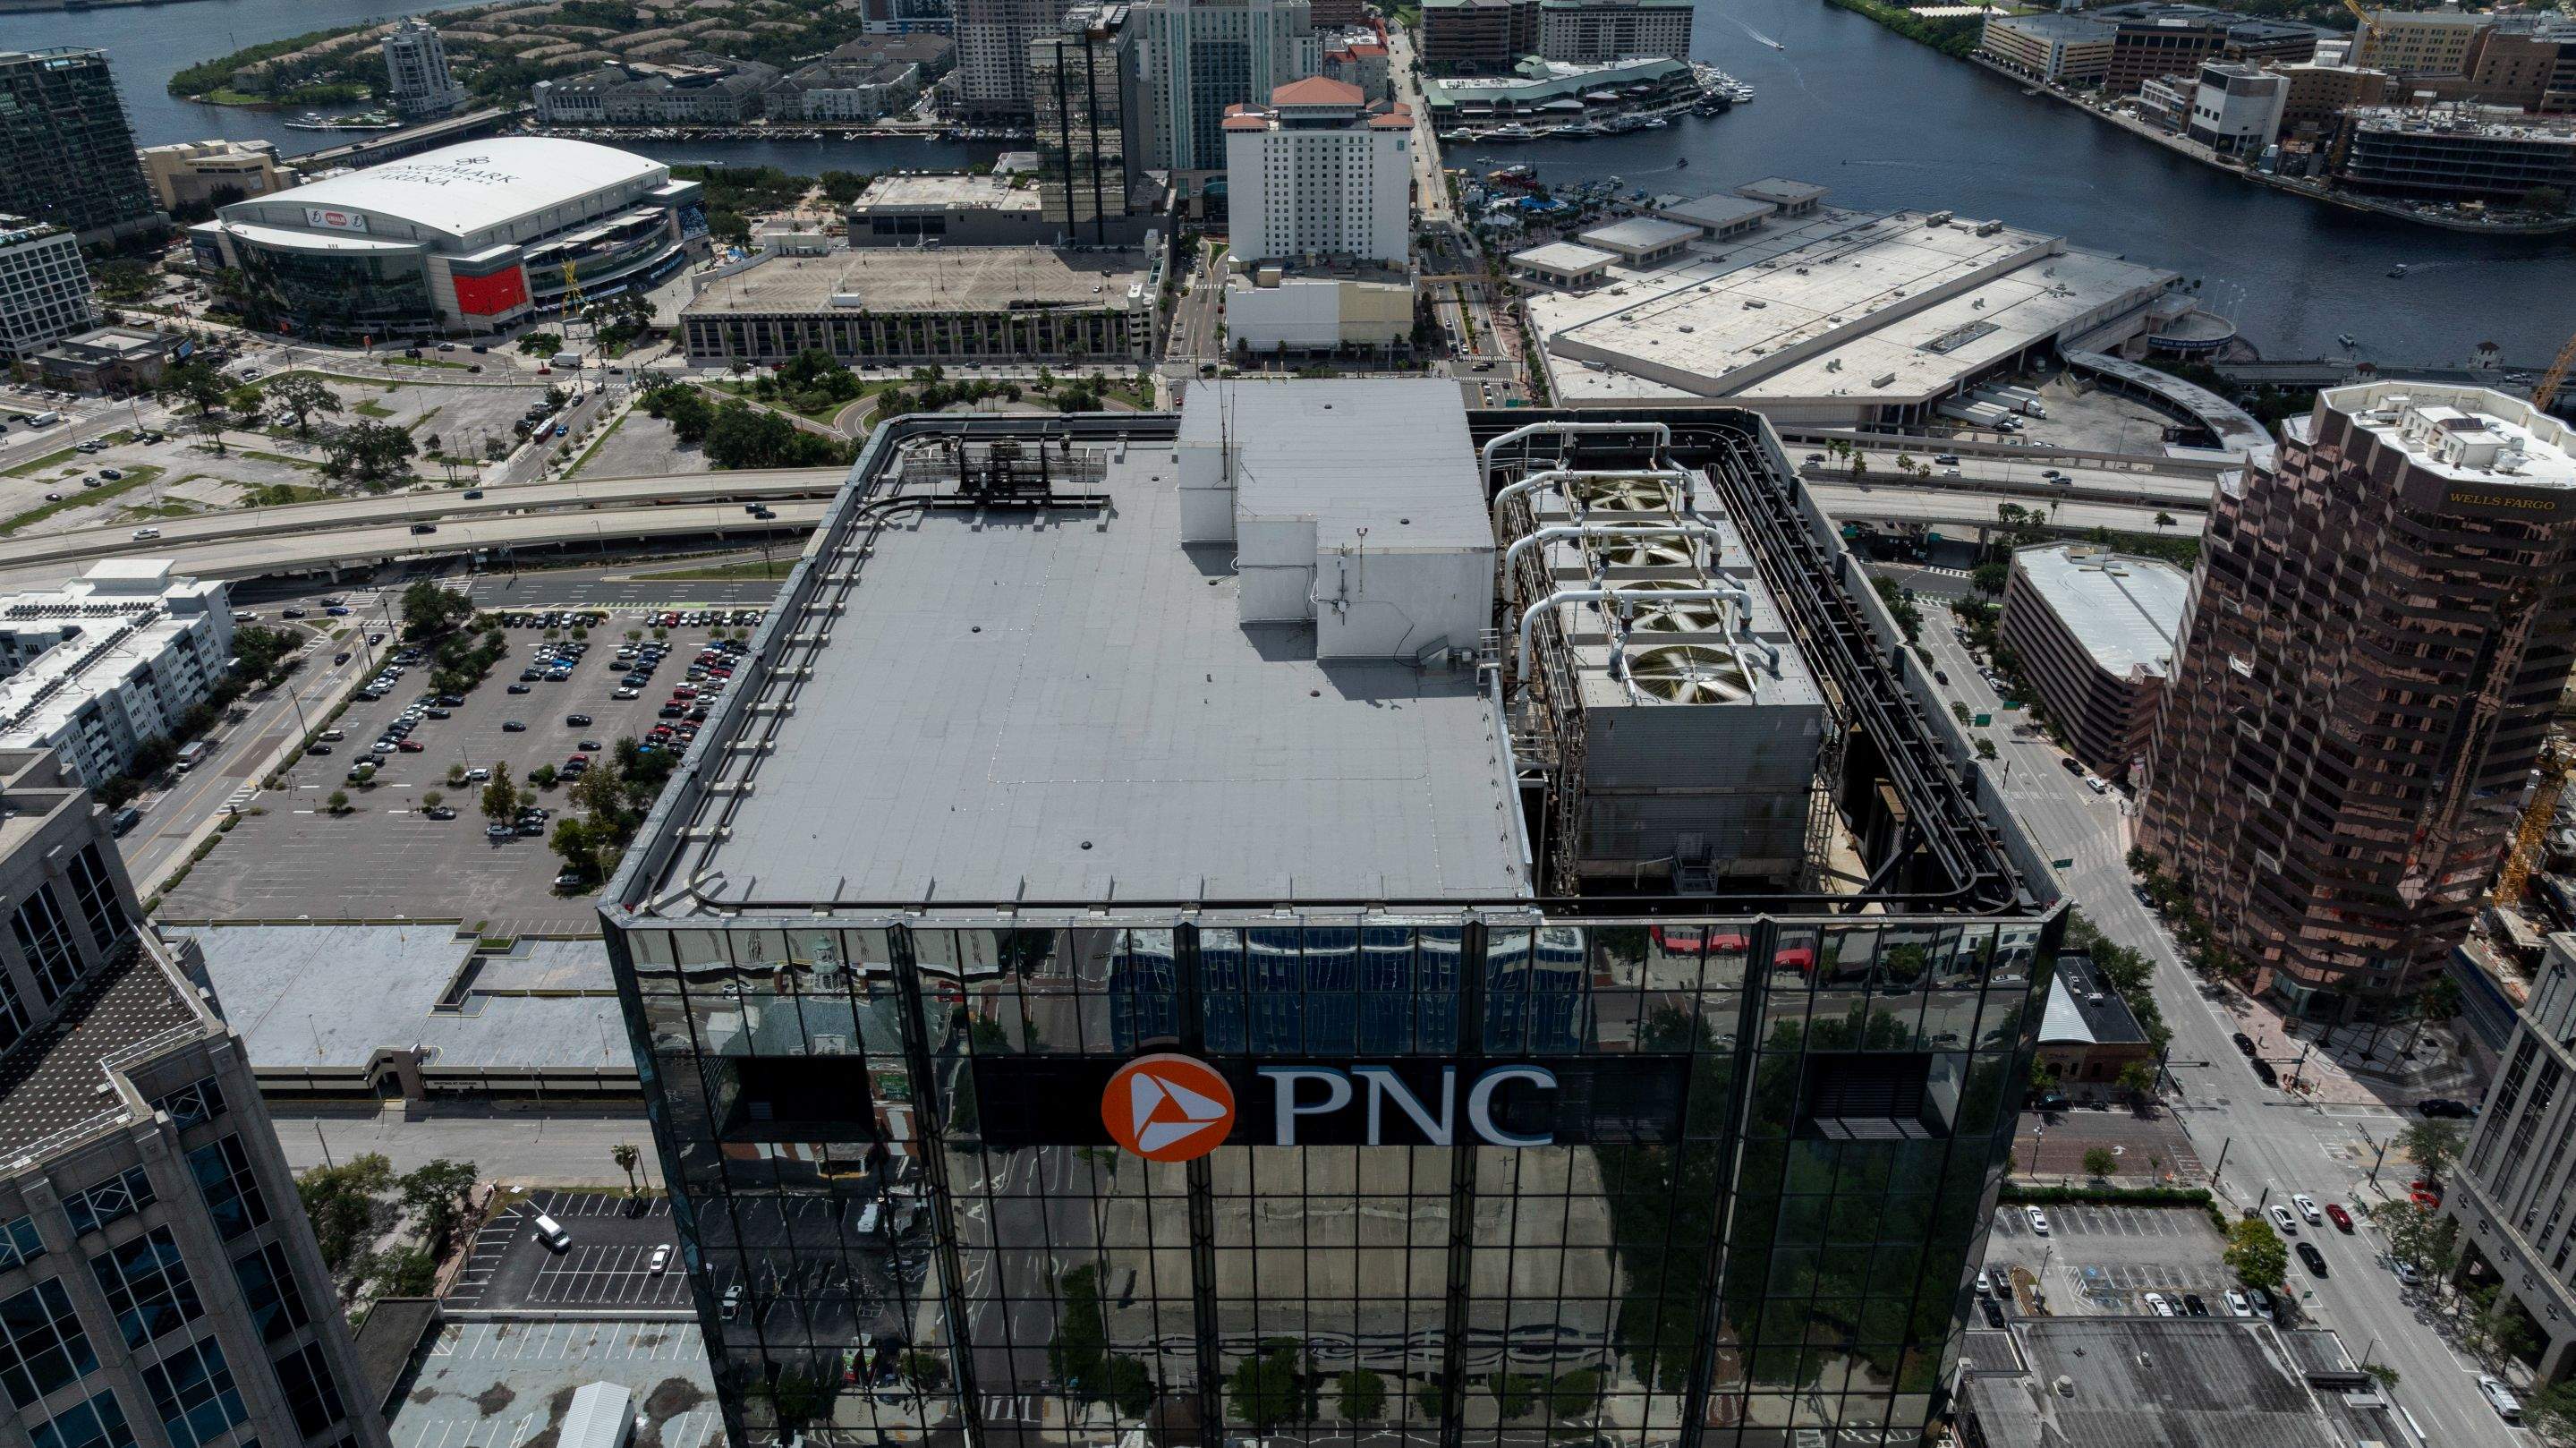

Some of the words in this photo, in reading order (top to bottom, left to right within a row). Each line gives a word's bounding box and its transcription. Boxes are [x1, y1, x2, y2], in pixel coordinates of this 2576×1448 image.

[2450, 493, 2502, 506] WELLS
[2504, 498, 2555, 510] FARGO
[1256, 1065, 1557, 1147] PNC
